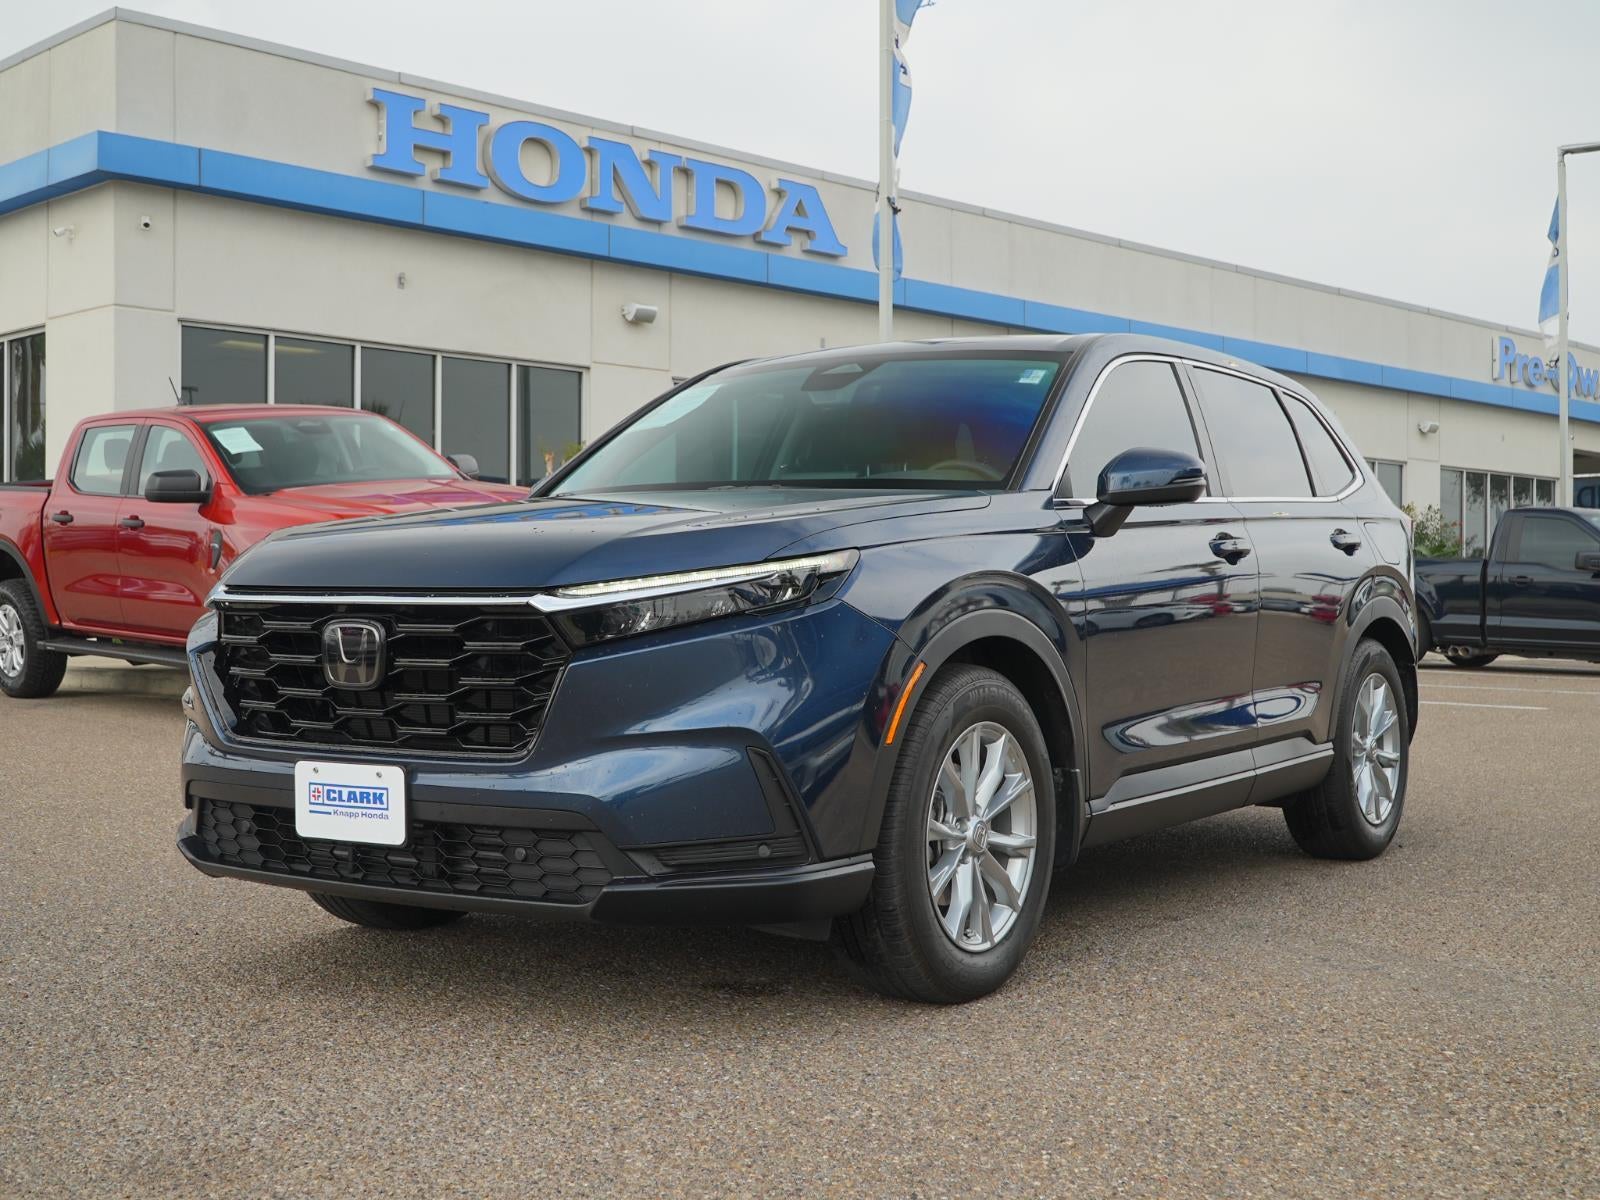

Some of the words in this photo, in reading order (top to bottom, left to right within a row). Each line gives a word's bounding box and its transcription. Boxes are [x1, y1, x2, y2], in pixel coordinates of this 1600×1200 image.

[366, 87, 847, 257] HONDA
[326, 788, 385, 805] CLARK
[333, 809, 360, 819] Knapp
[361, 812, 389, 820] Honda
